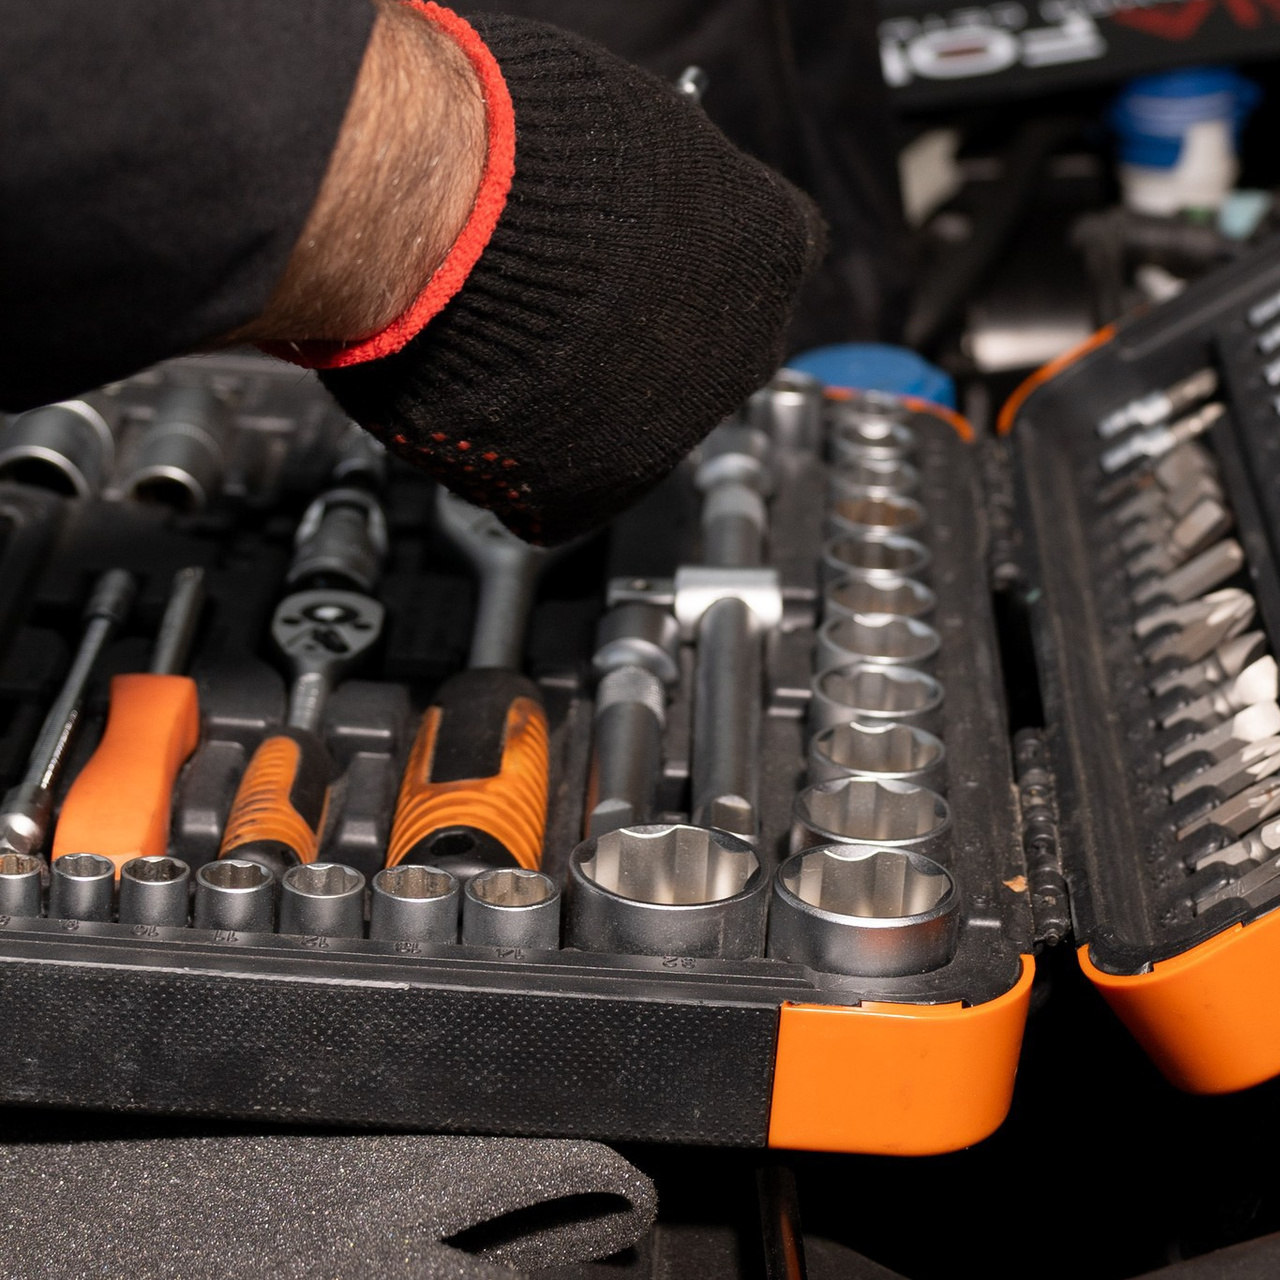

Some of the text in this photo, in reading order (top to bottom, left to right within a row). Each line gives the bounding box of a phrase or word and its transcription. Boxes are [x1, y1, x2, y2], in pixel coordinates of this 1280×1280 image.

[214, 930, 239, 943] 11
[301, 936, 330, 949] 12
[495, 948, 525, 961] 14
